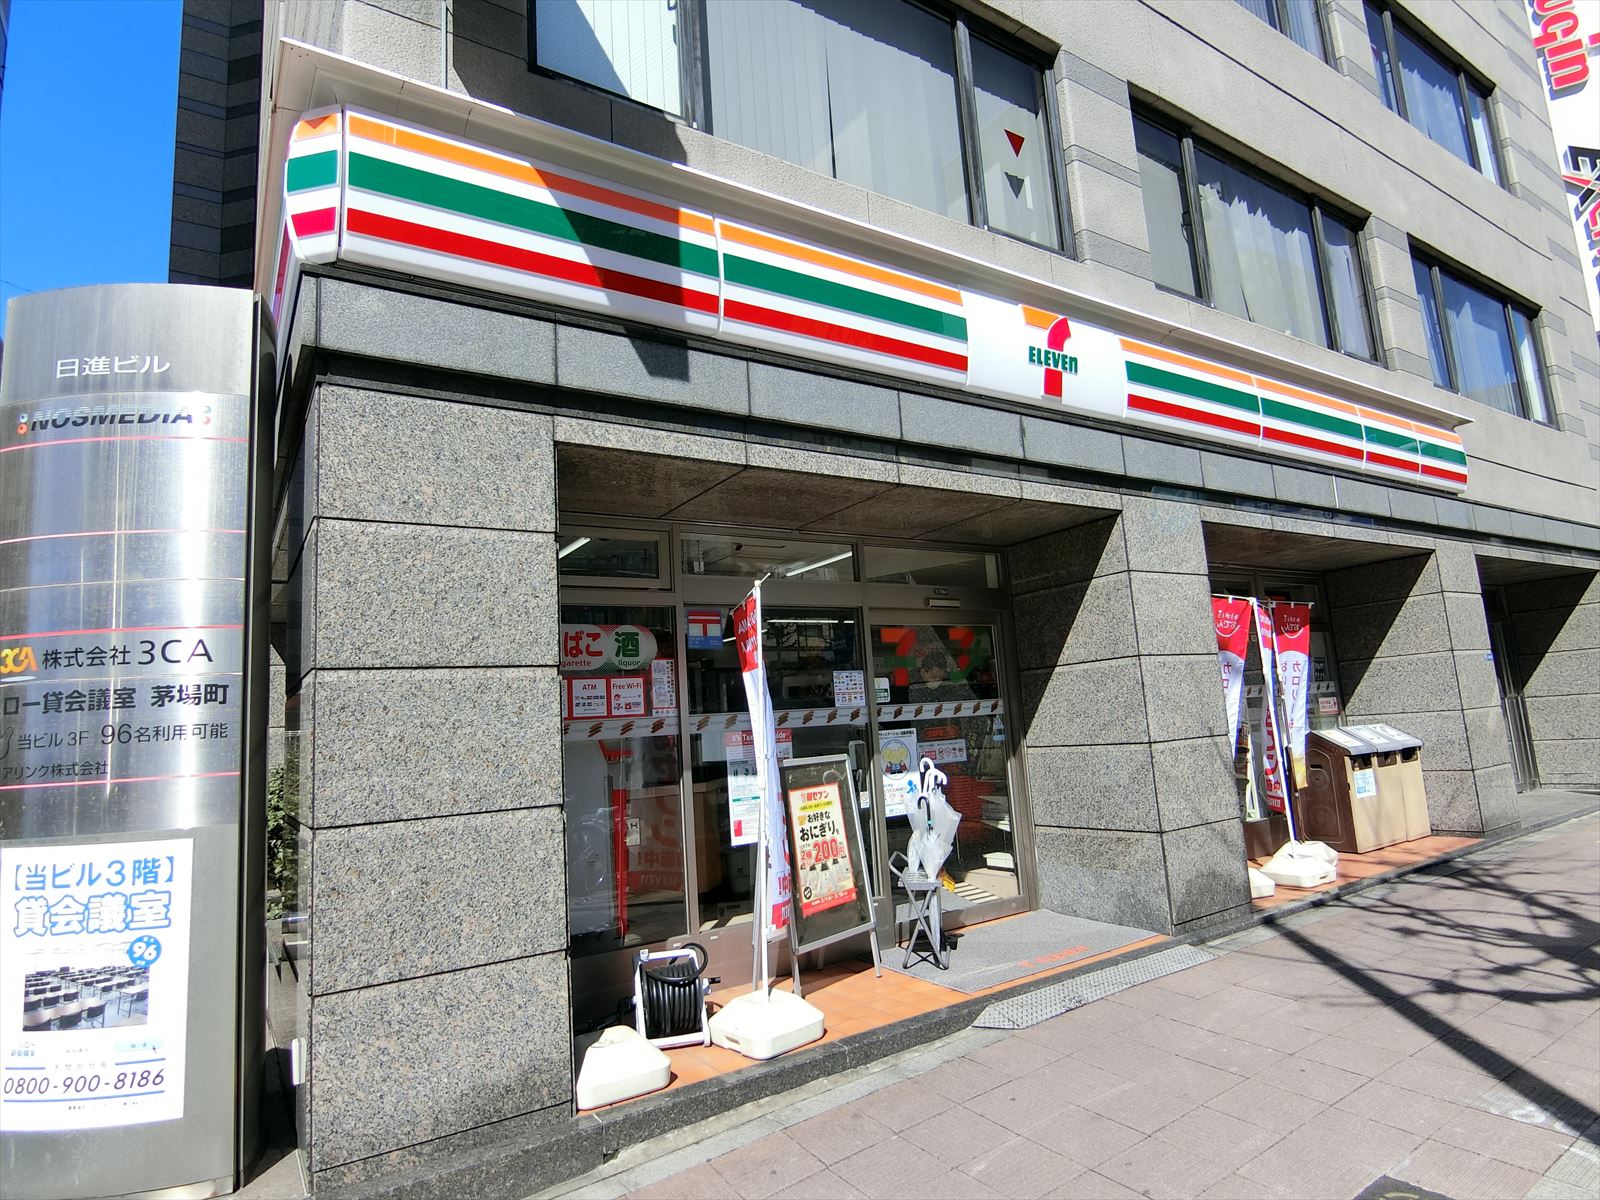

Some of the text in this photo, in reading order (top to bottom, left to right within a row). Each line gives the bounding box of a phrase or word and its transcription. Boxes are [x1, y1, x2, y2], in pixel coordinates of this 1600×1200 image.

[56, 355, 171, 379] 日進ビル
[563, 630, 603, 658] ばこ
[614, 631, 641, 658] 酒
[619, 659, 641, 668] liquor
[150, 683, 230, 708] 茅場町
[582, 683, 598, 691] ATM
[627, 682, 642, 690] Wi-Fi
[100, 723, 229, 746] 96名利用可能
[807, 810, 831, 824] お好きな
[13, 889, 172, 938] 貸会議室
[132, 941, 158, 961] 96
[3, 1067, 165, 1095] 0800-900-8186
